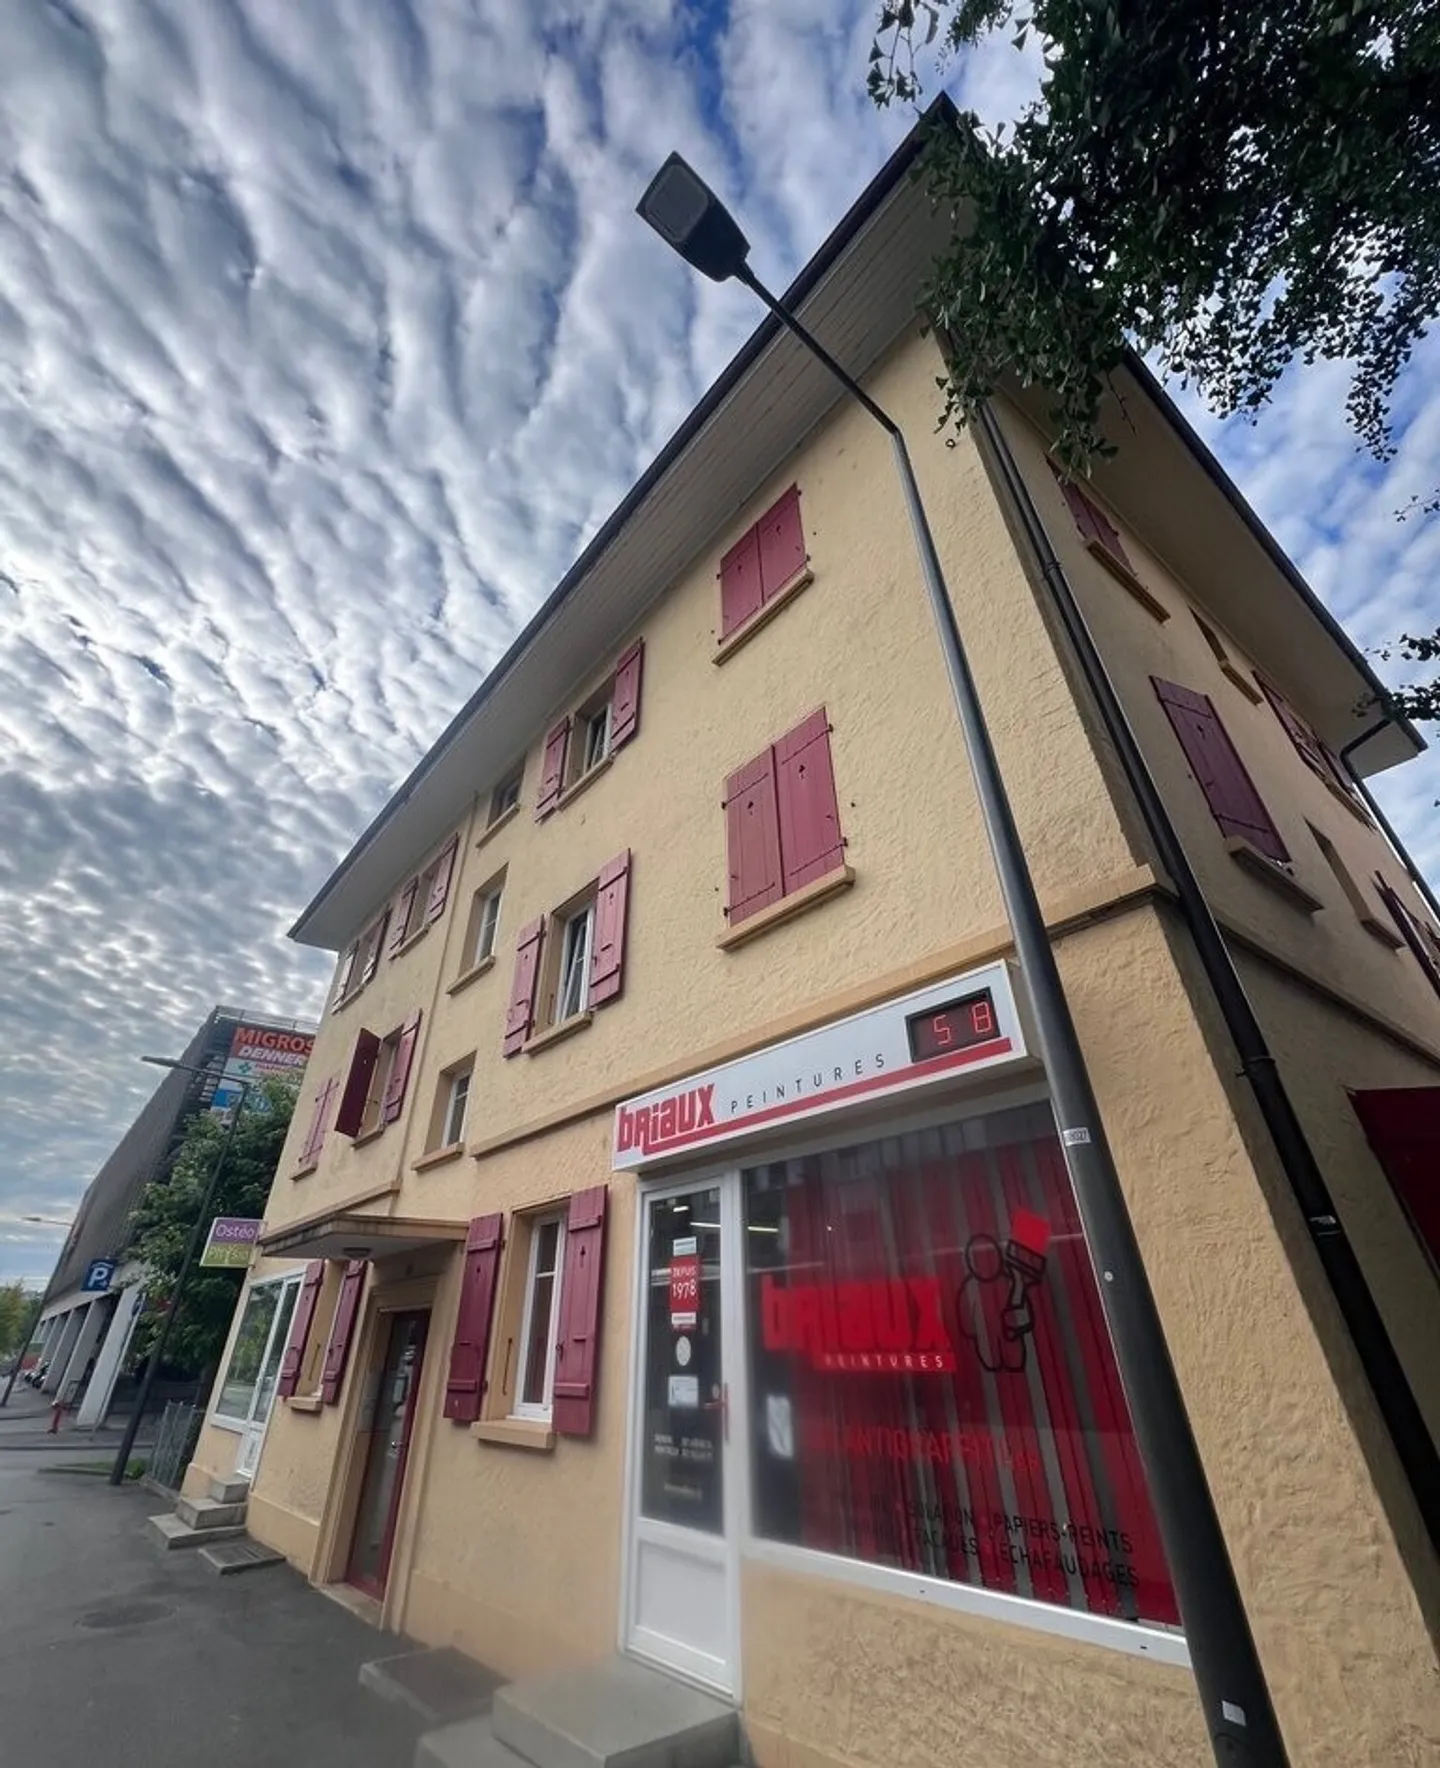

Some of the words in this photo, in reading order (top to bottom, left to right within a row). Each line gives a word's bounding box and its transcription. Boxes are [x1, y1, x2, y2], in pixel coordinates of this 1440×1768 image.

[237, 1027, 316, 1053] MIGROS
[237, 1045, 306, 1066] DENNER
[731, 1054, 885, 1114] PEINTURES
[88, 1267, 108, 1289] P
[672, 1278, 696, 1300] 1978
